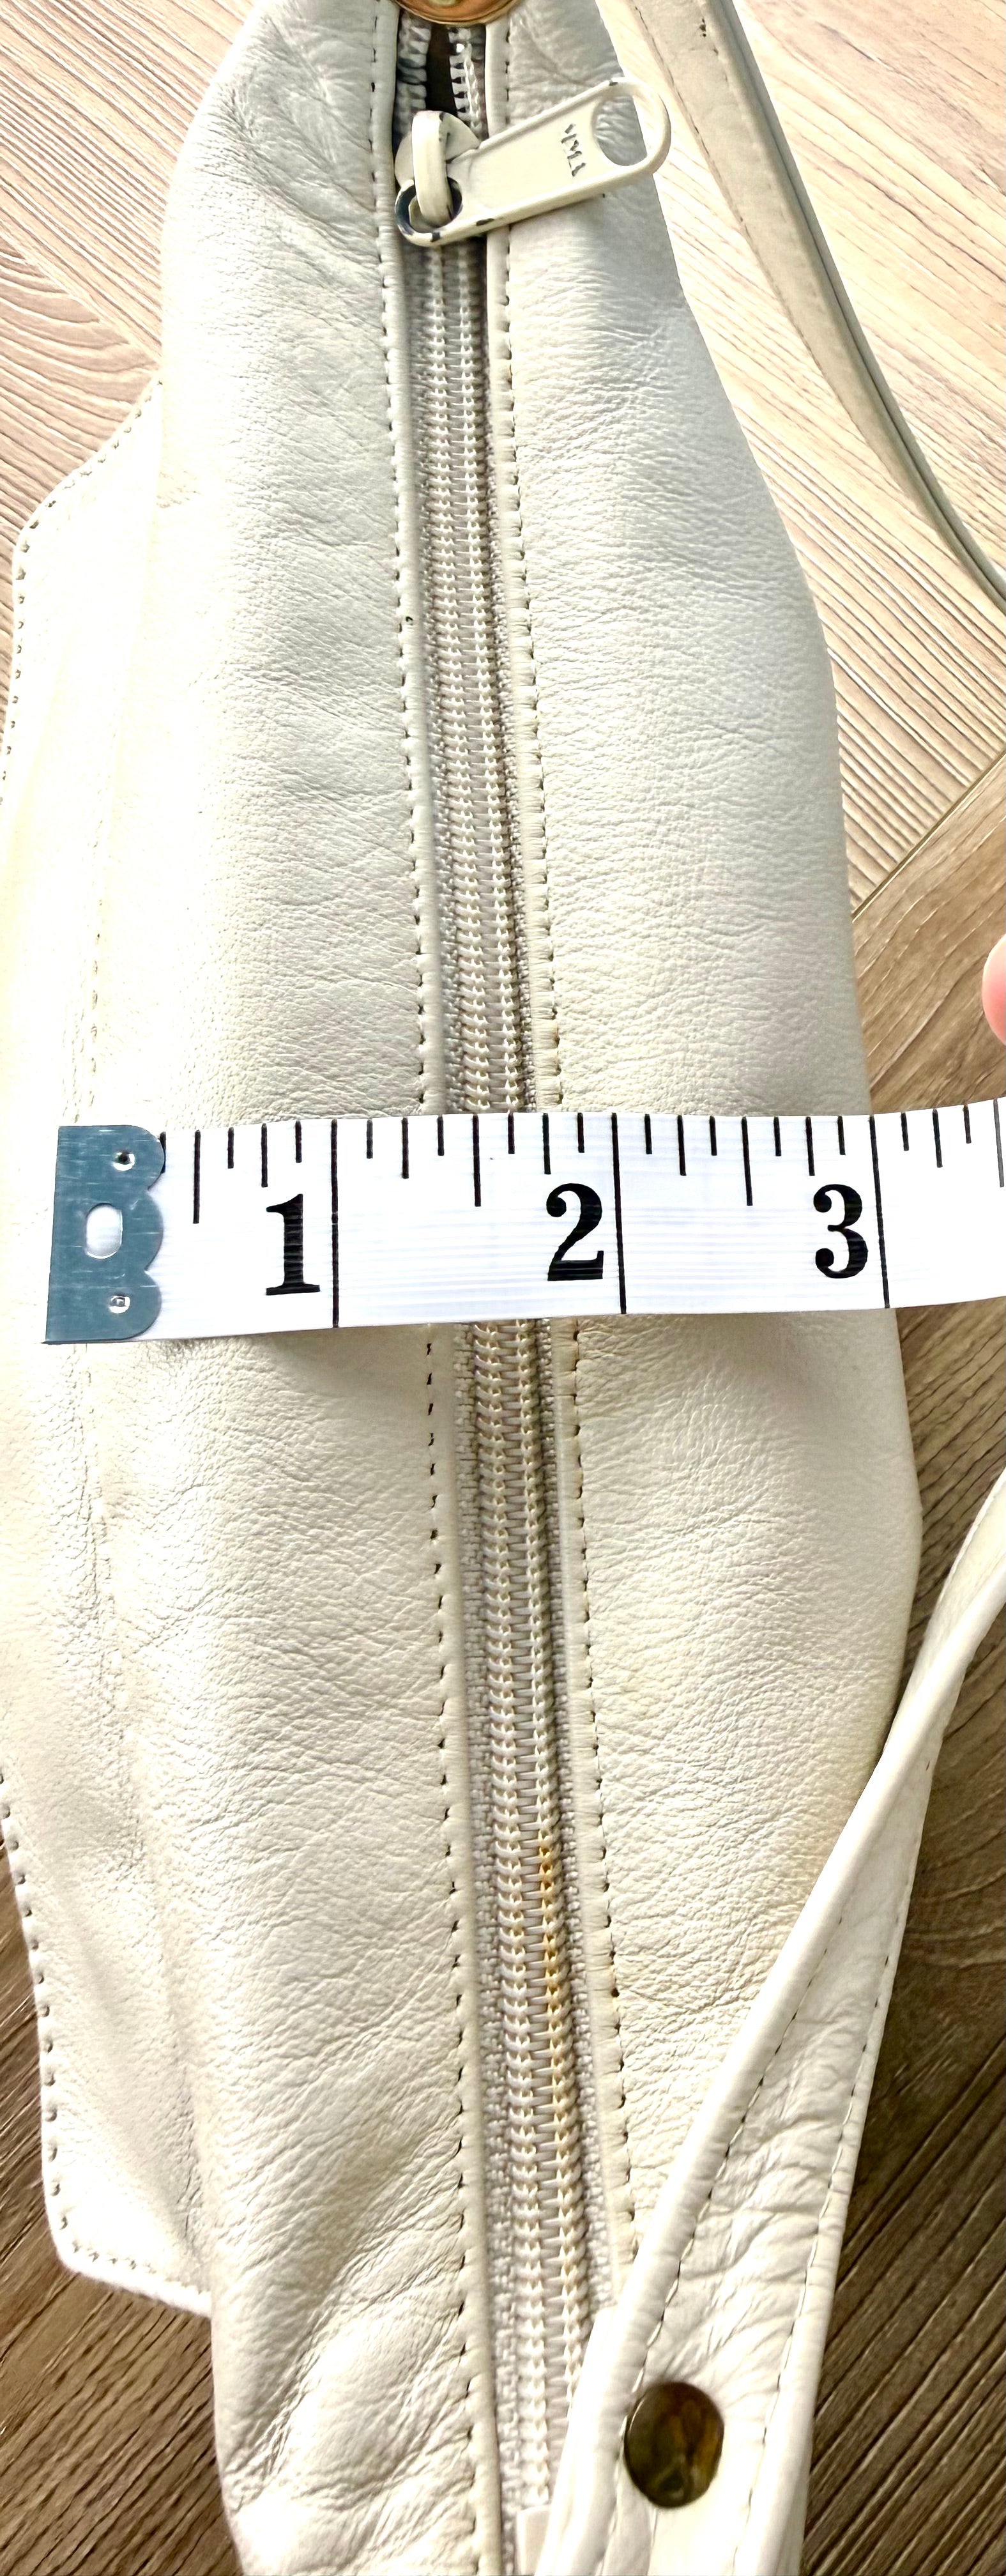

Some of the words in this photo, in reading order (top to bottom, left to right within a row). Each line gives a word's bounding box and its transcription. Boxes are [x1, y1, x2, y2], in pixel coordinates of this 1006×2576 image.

[266, 1193, 321, 1296] 1
[545, 1183, 604, 1282] 2
[813, 1184, 869, 1279] 3
